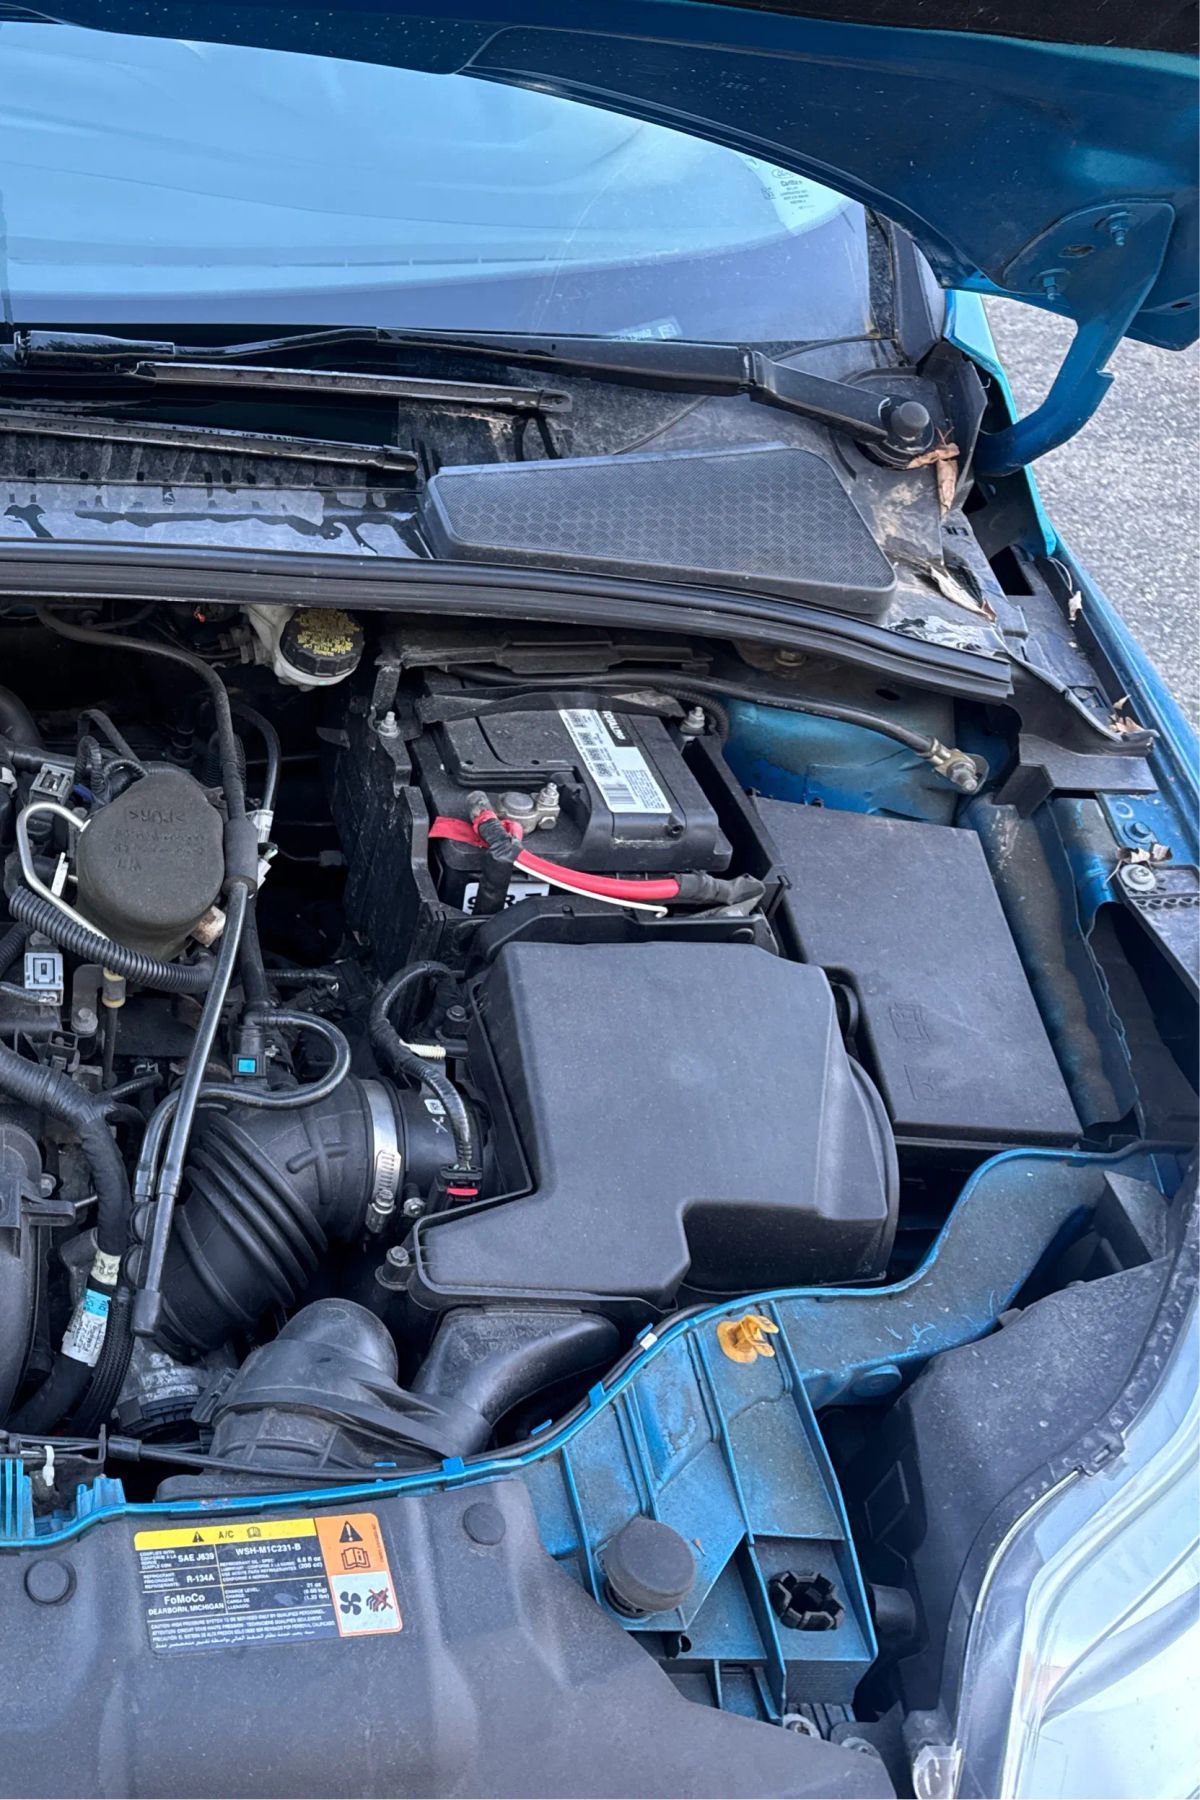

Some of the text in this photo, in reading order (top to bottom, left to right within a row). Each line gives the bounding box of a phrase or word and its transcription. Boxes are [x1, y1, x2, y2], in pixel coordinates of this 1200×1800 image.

[219, 1530, 234, 1539] A/C
[178, 1554, 195, 1562] SAE
[186, 1574, 215, 1583] R-134A
[164, 1593, 205, 1605] FoMoCo
[190, 1603, 224, 1611] MICHIGAN
